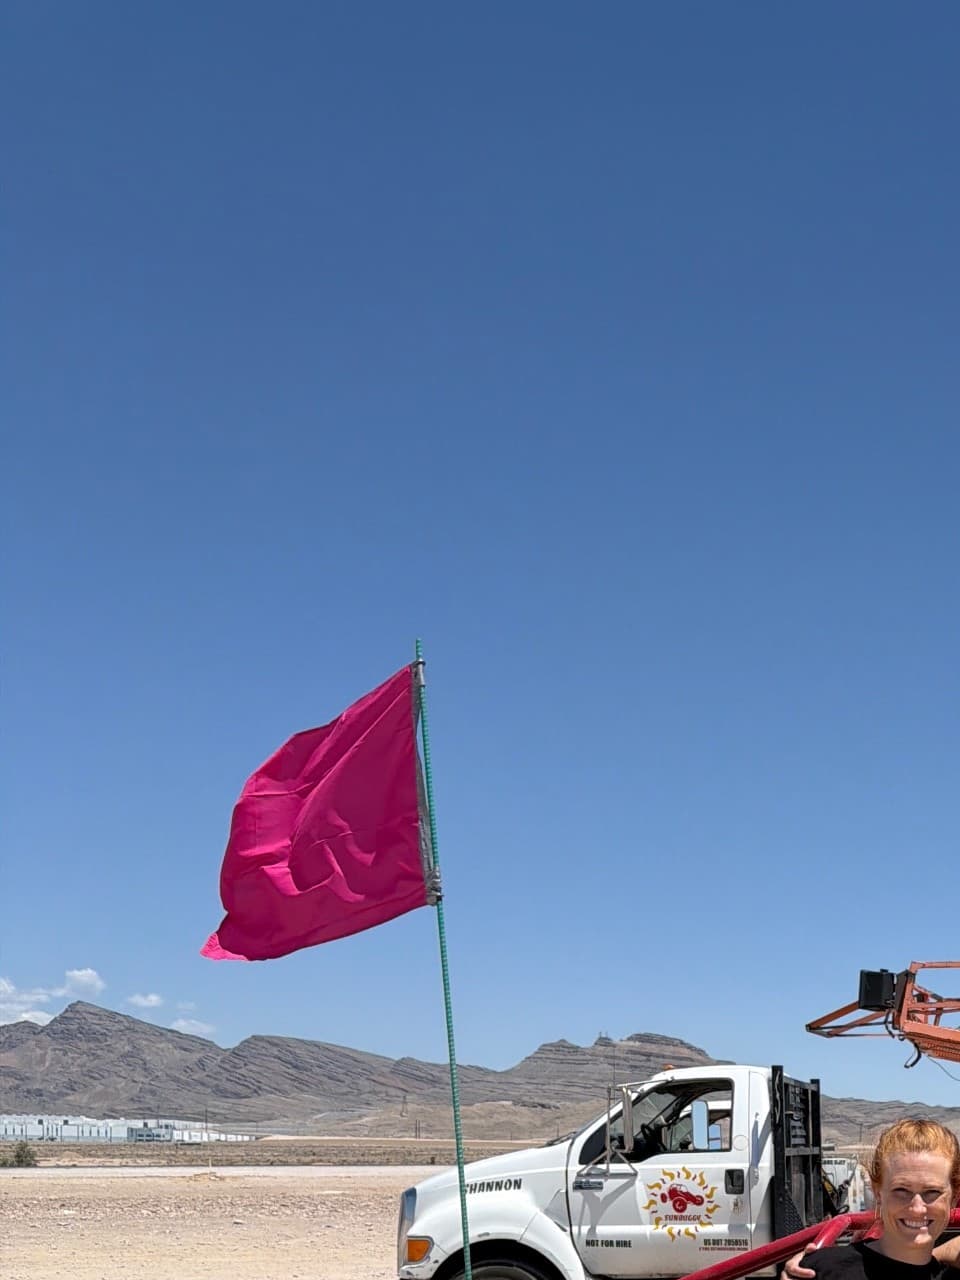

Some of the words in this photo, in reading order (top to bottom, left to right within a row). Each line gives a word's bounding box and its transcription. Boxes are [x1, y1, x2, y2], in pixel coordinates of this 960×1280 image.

[585, 1239, 599, 1248] NOT
[601, 1239, 615, 1248] FOR
[615, 1239, 632, 1248] HIRE
